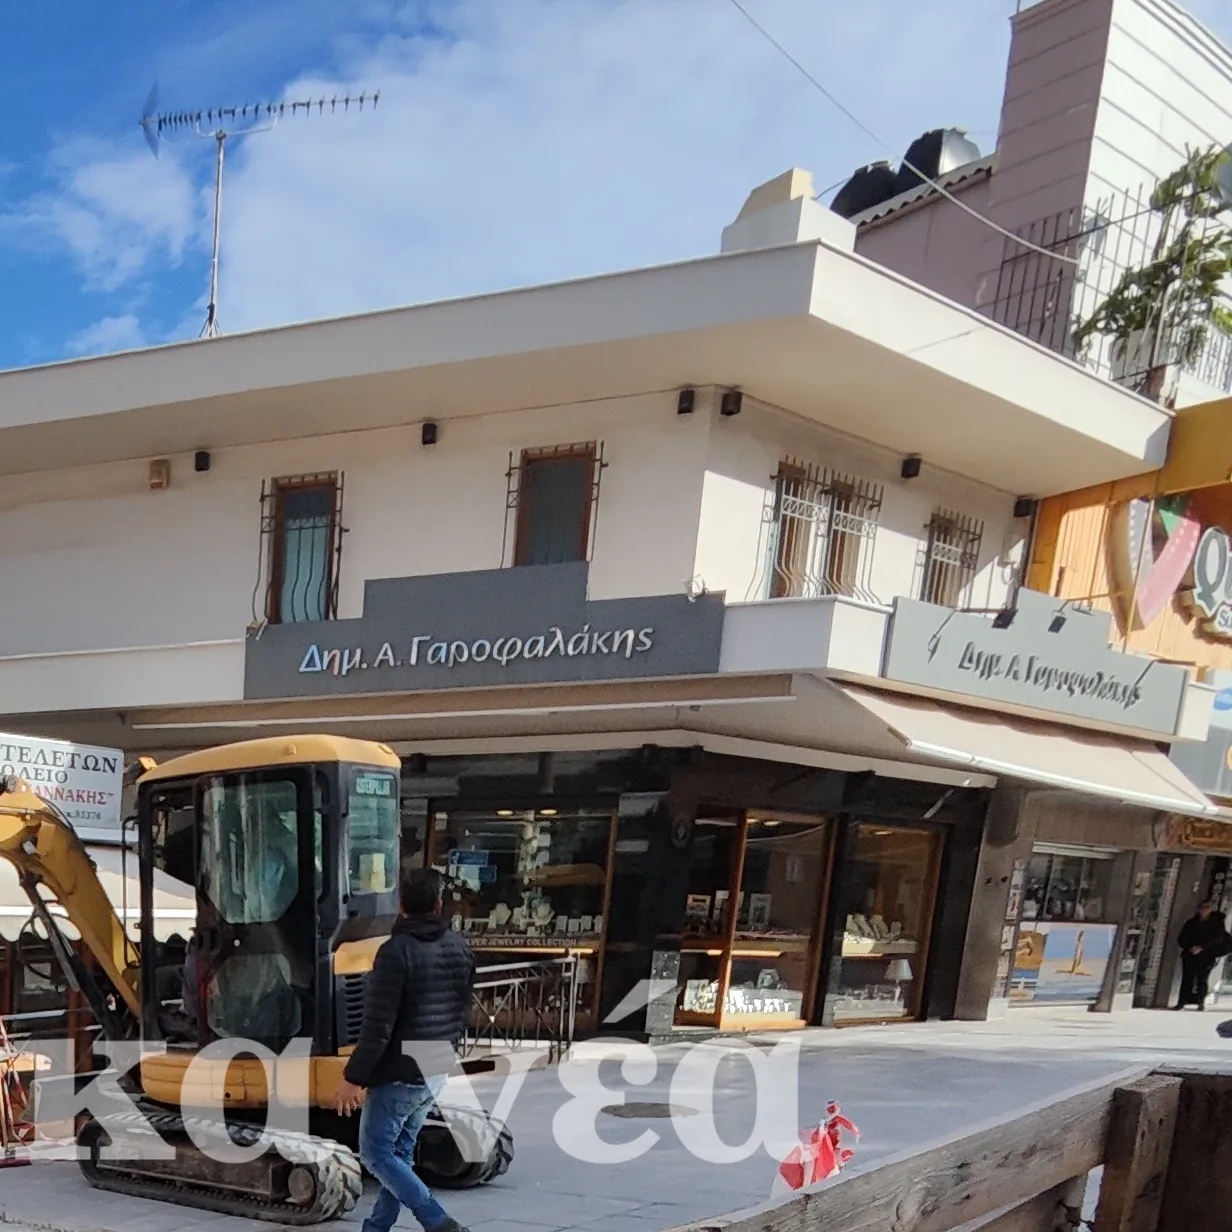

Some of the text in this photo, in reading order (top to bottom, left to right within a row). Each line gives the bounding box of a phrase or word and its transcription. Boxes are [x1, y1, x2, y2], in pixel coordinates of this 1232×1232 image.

[299, 644, 368, 674] Δημ.
[411, 623, 653, 666] Γαροφαλάκης
[0, 744, 118, 774] ΤΕΛΕΤΩΝ
